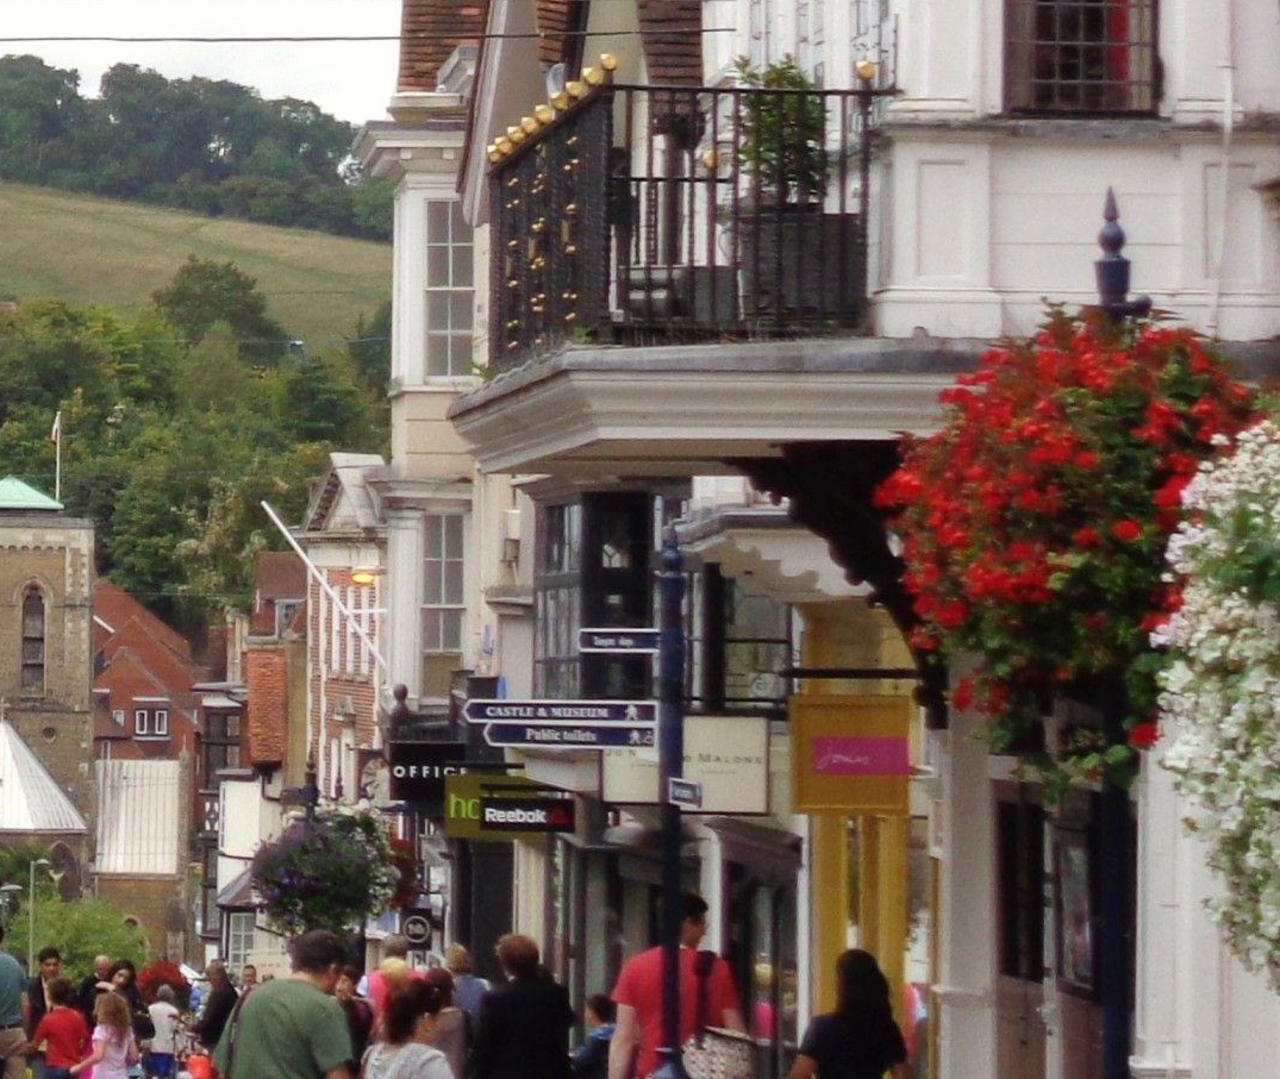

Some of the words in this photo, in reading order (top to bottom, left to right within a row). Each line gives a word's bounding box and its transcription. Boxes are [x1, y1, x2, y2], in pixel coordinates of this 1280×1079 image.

[485, 706, 535, 718] CASTLE
[537, 707, 548, 718] &
[551, 707, 609, 718] MUSEUM
[525, 727, 561, 741] Public
[563, 729, 598, 742] toilets
[484, 807, 548, 824] Reebok
